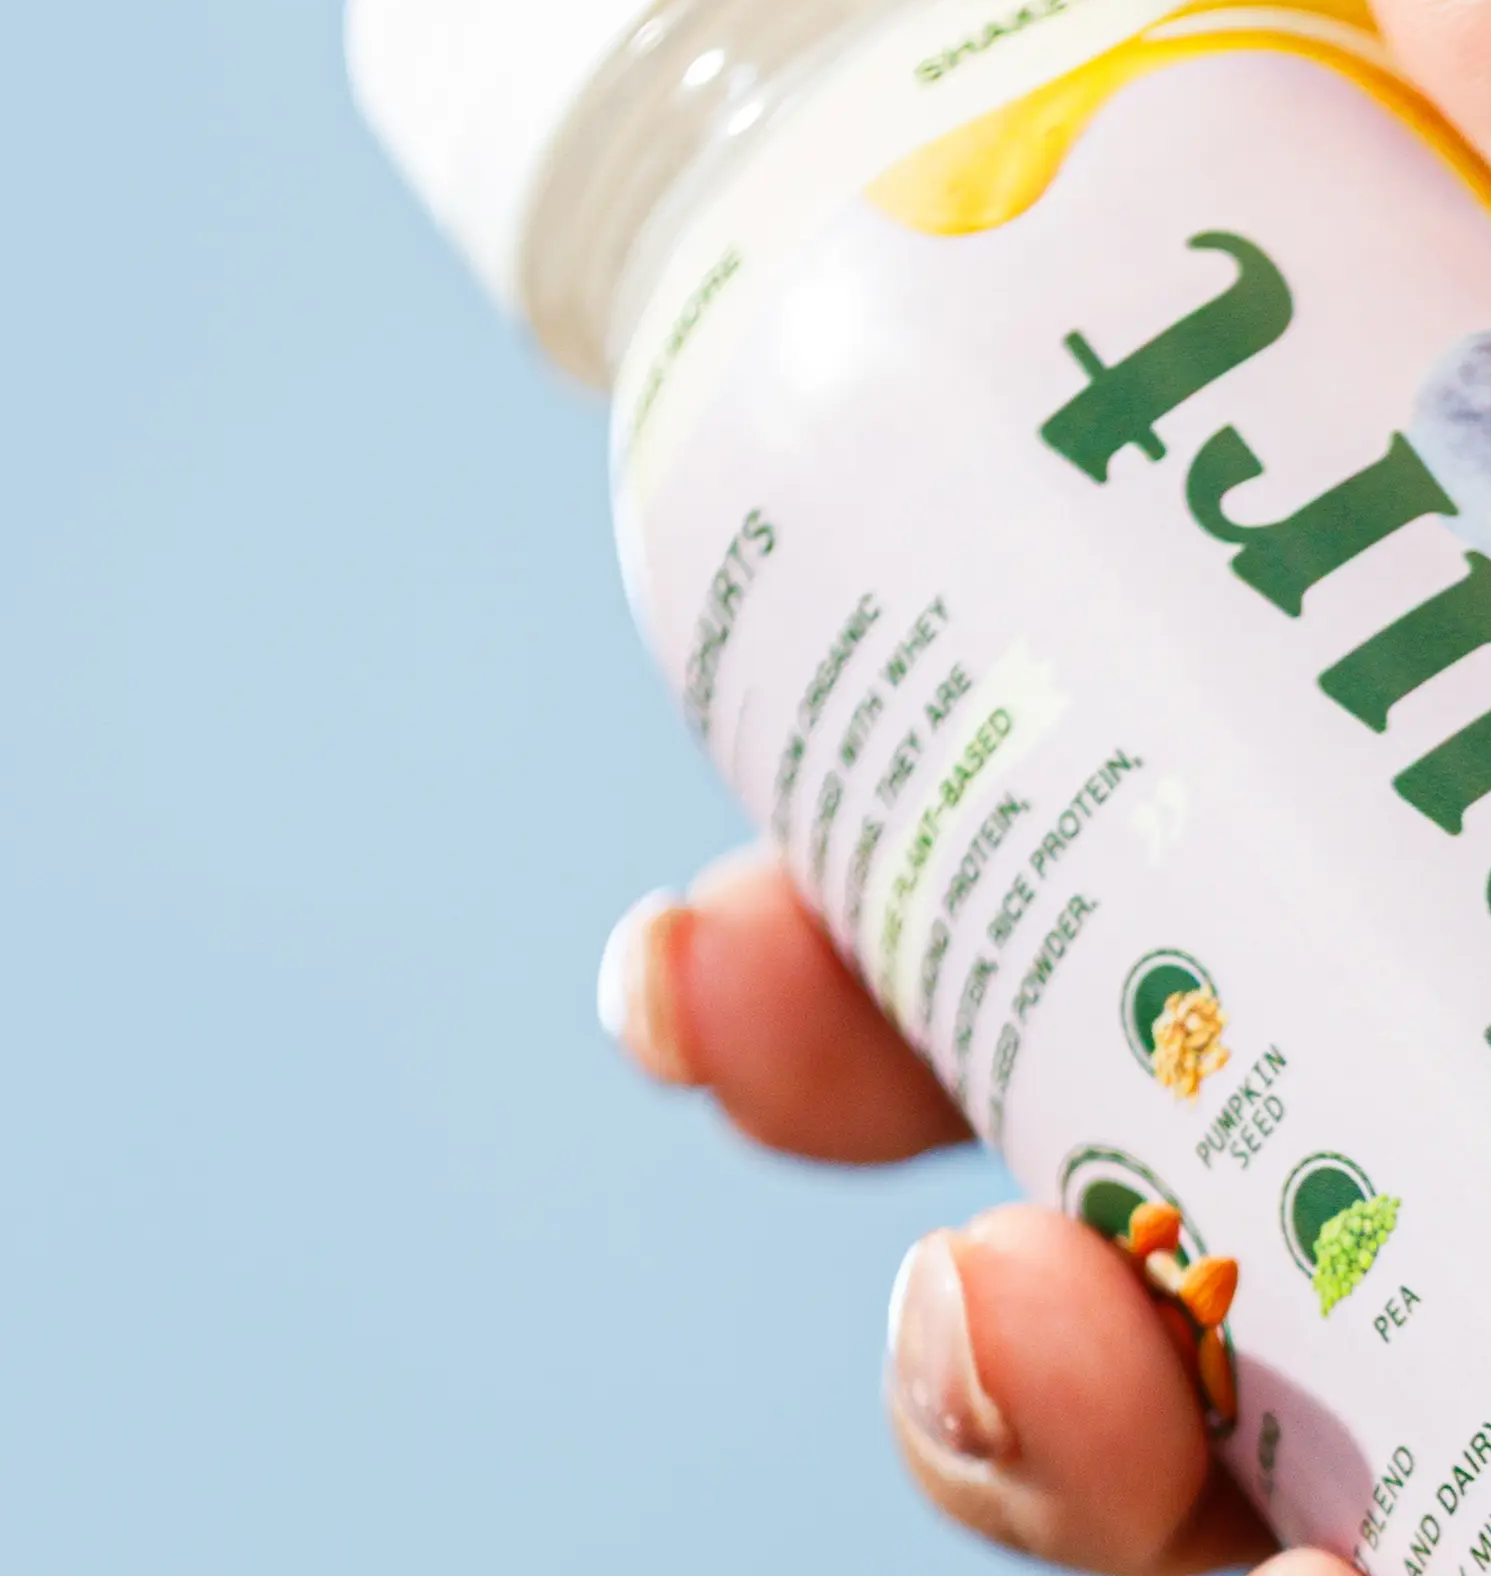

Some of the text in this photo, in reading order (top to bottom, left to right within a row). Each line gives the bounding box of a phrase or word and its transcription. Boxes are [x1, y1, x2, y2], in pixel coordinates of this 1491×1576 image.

[882, 593, 950, 688] WHEY
[924, 661, 974, 732] ARE
[986, 871, 1037, 948] RICE
[1029, 748, 1144, 880] PROTEIN,
[1011, 892, 1100, 1018] POWDER.
[1195, 1043, 1288, 1170] PUMPKIN
[1229, 1093, 1286, 1170] SEED
[1373, 1284, 1422, 1344] PEA
[1358, 1445, 1416, 1551] BLEND
